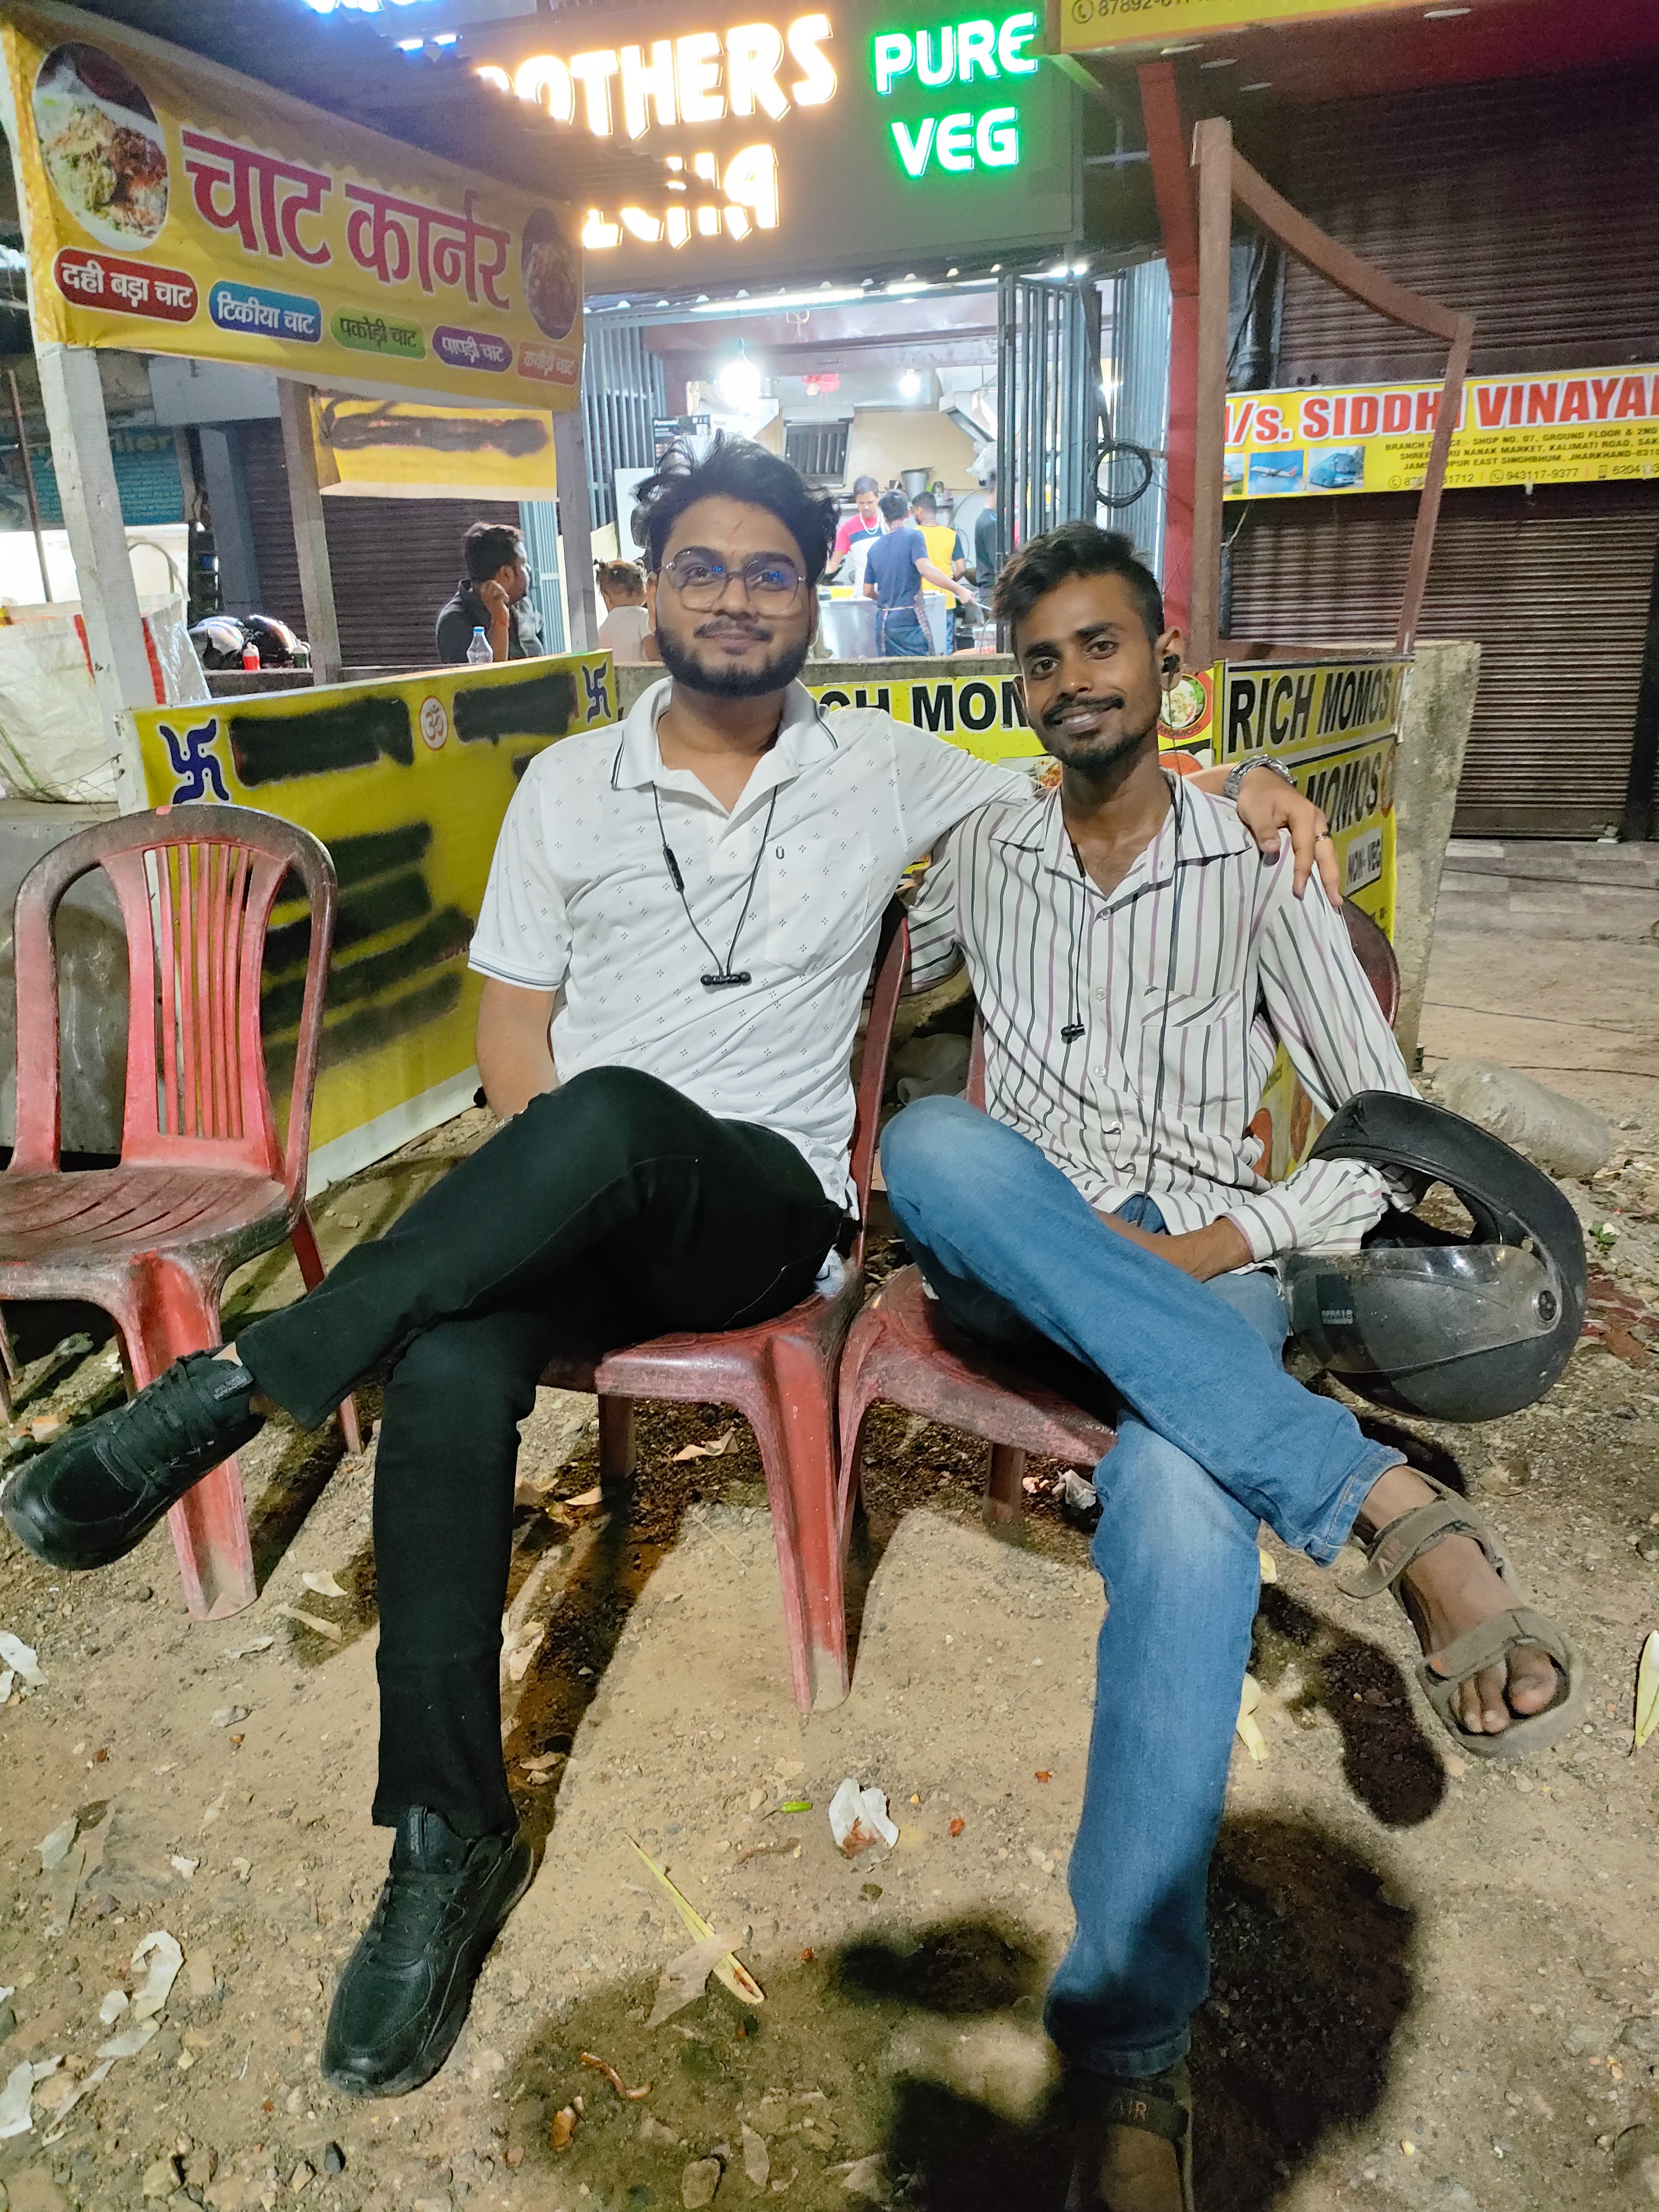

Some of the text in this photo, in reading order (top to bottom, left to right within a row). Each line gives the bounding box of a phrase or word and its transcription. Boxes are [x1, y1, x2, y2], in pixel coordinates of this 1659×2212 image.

[477, 13, 838, 140] OTHERS
[874, 11, 1038, 95] PURE
[892, 107, 1019, 177] VEG
[181, 130, 332, 266] चाट
[61, 259, 193, 309] दही बड़ा चाट
[217, 291, 315, 334] टिकीया चाट
[389, 328, 417, 347] चाट
[479, 343, 506, 362] चाट
[1303, 390, 1461, 439] SIDDH
[1477, 376, 1659, 427] VINAYA
[1385, 442, 1425, 451] BRANCH
[1543, 432, 1584, 441] GROUND
[1588, 429, 1622, 437] FLOOR
[1464, 447, 1497, 455] NANAK
[1549, 442, 1598, 451] KALIMATI
[1228, 668, 1393, 753] RICH MOMOS
